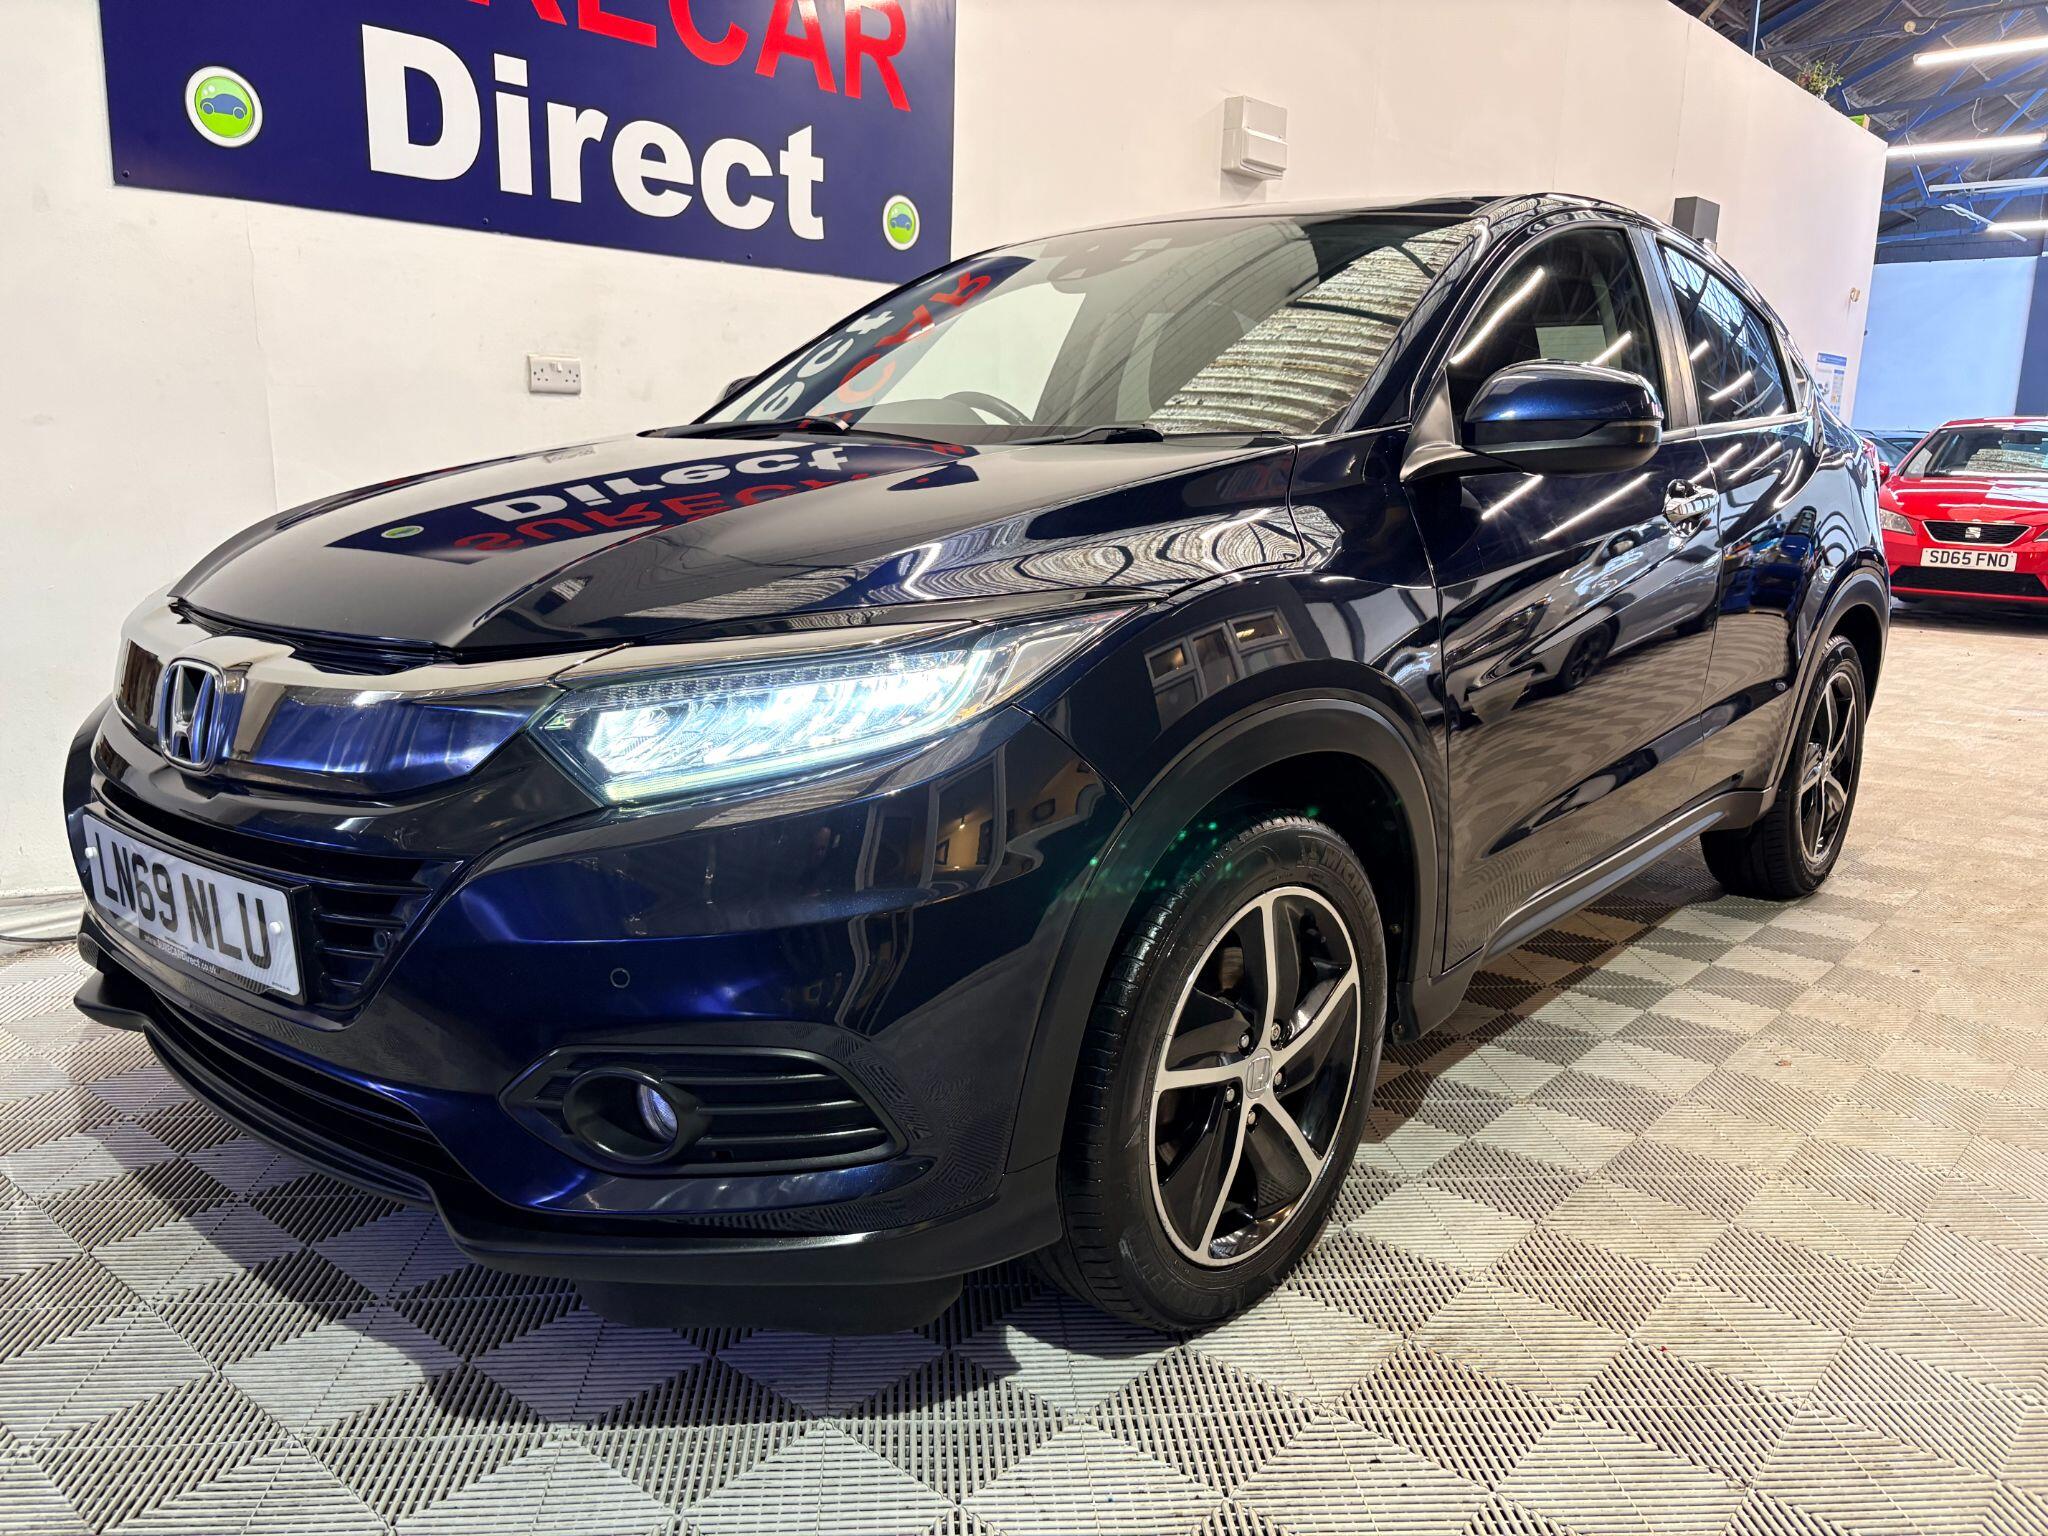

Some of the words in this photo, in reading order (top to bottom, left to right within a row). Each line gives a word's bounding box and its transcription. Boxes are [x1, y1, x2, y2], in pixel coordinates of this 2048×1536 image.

[467, 0, 911, 112] CAR
[361, 24, 825, 240] Direct
[1929, 550, 1973, 565] SD65
[1975, 552, 2009, 567] FNO
[94, 832, 179, 933] LN69
[181, 872, 272, 970] NLU
